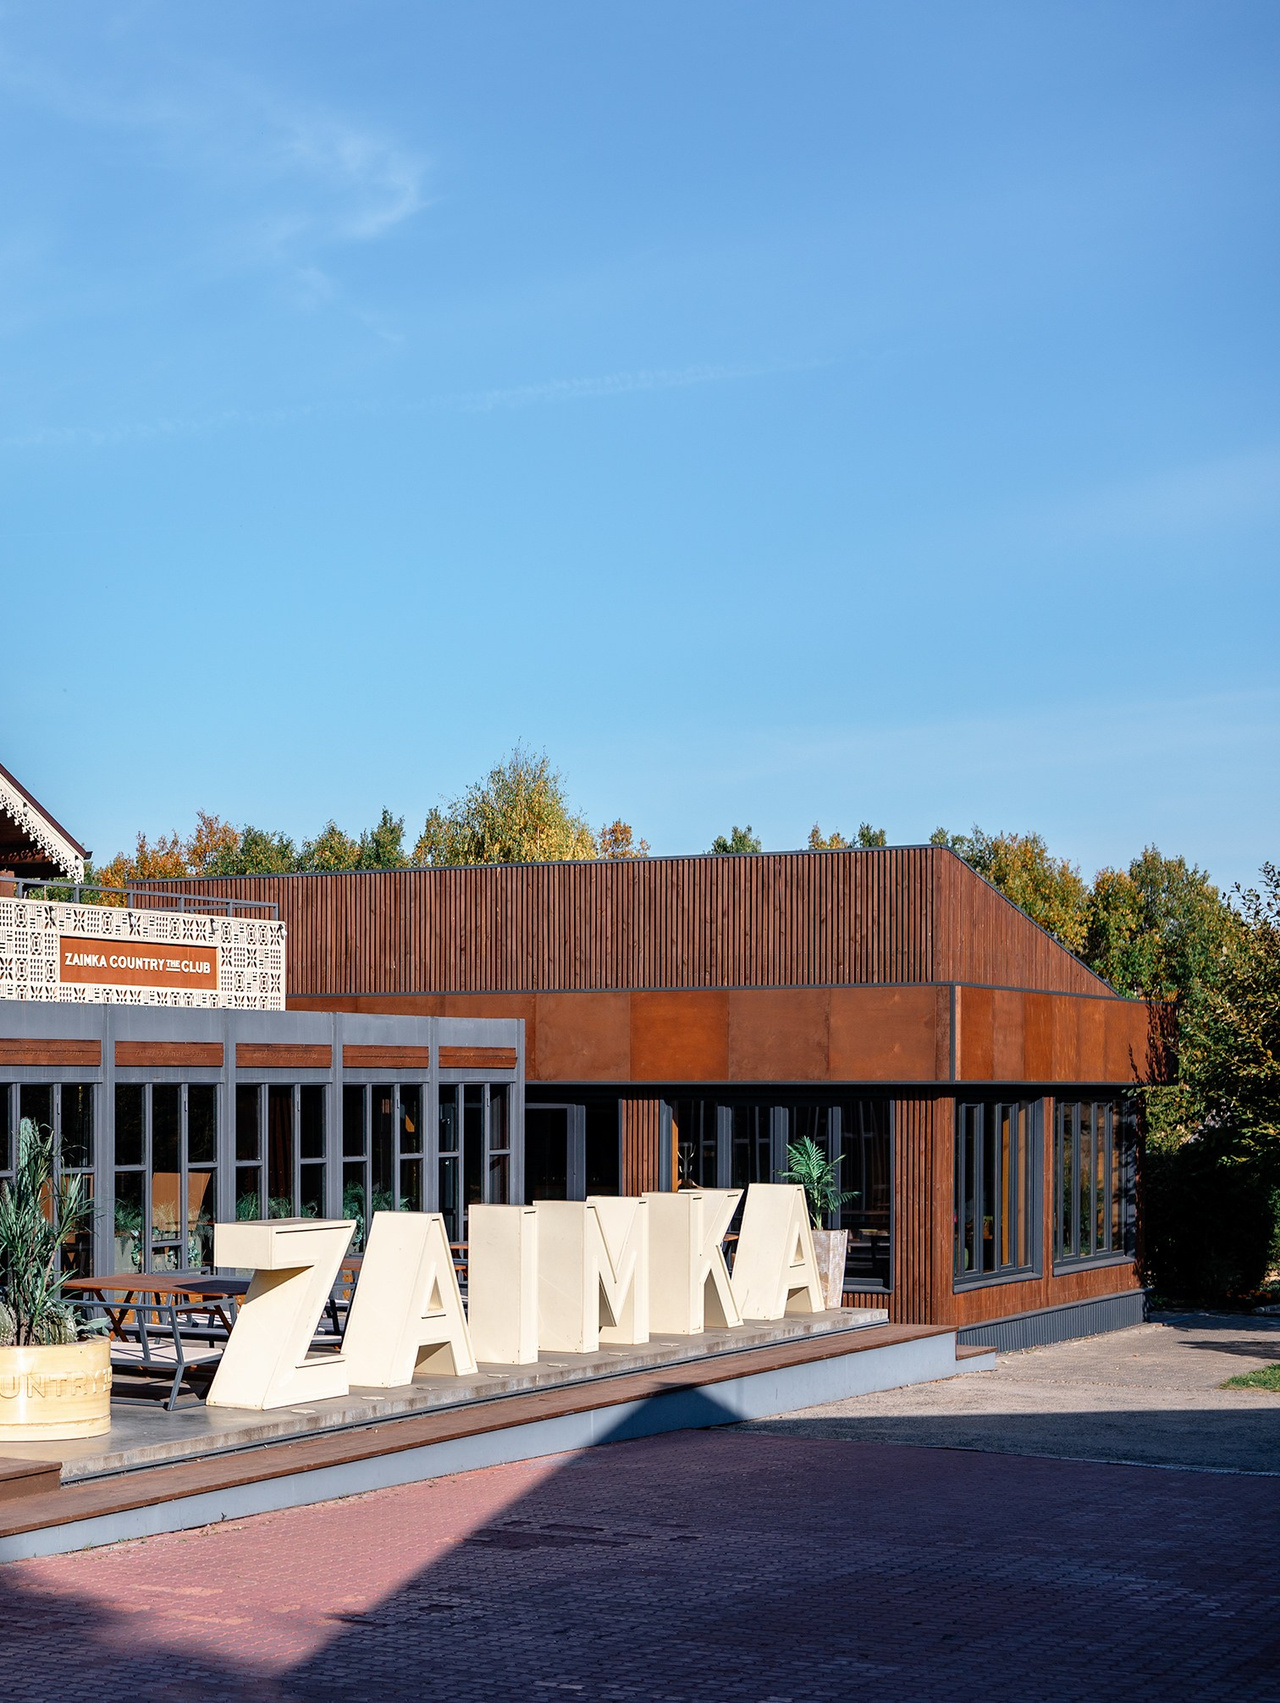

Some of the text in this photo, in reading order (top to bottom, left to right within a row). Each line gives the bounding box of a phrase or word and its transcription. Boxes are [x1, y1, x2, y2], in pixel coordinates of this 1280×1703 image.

[65, 953, 211, 974] ZAIMKA COUNTRY THE CLUB
[206, 1183, 825, 1410] ZAIMKA
